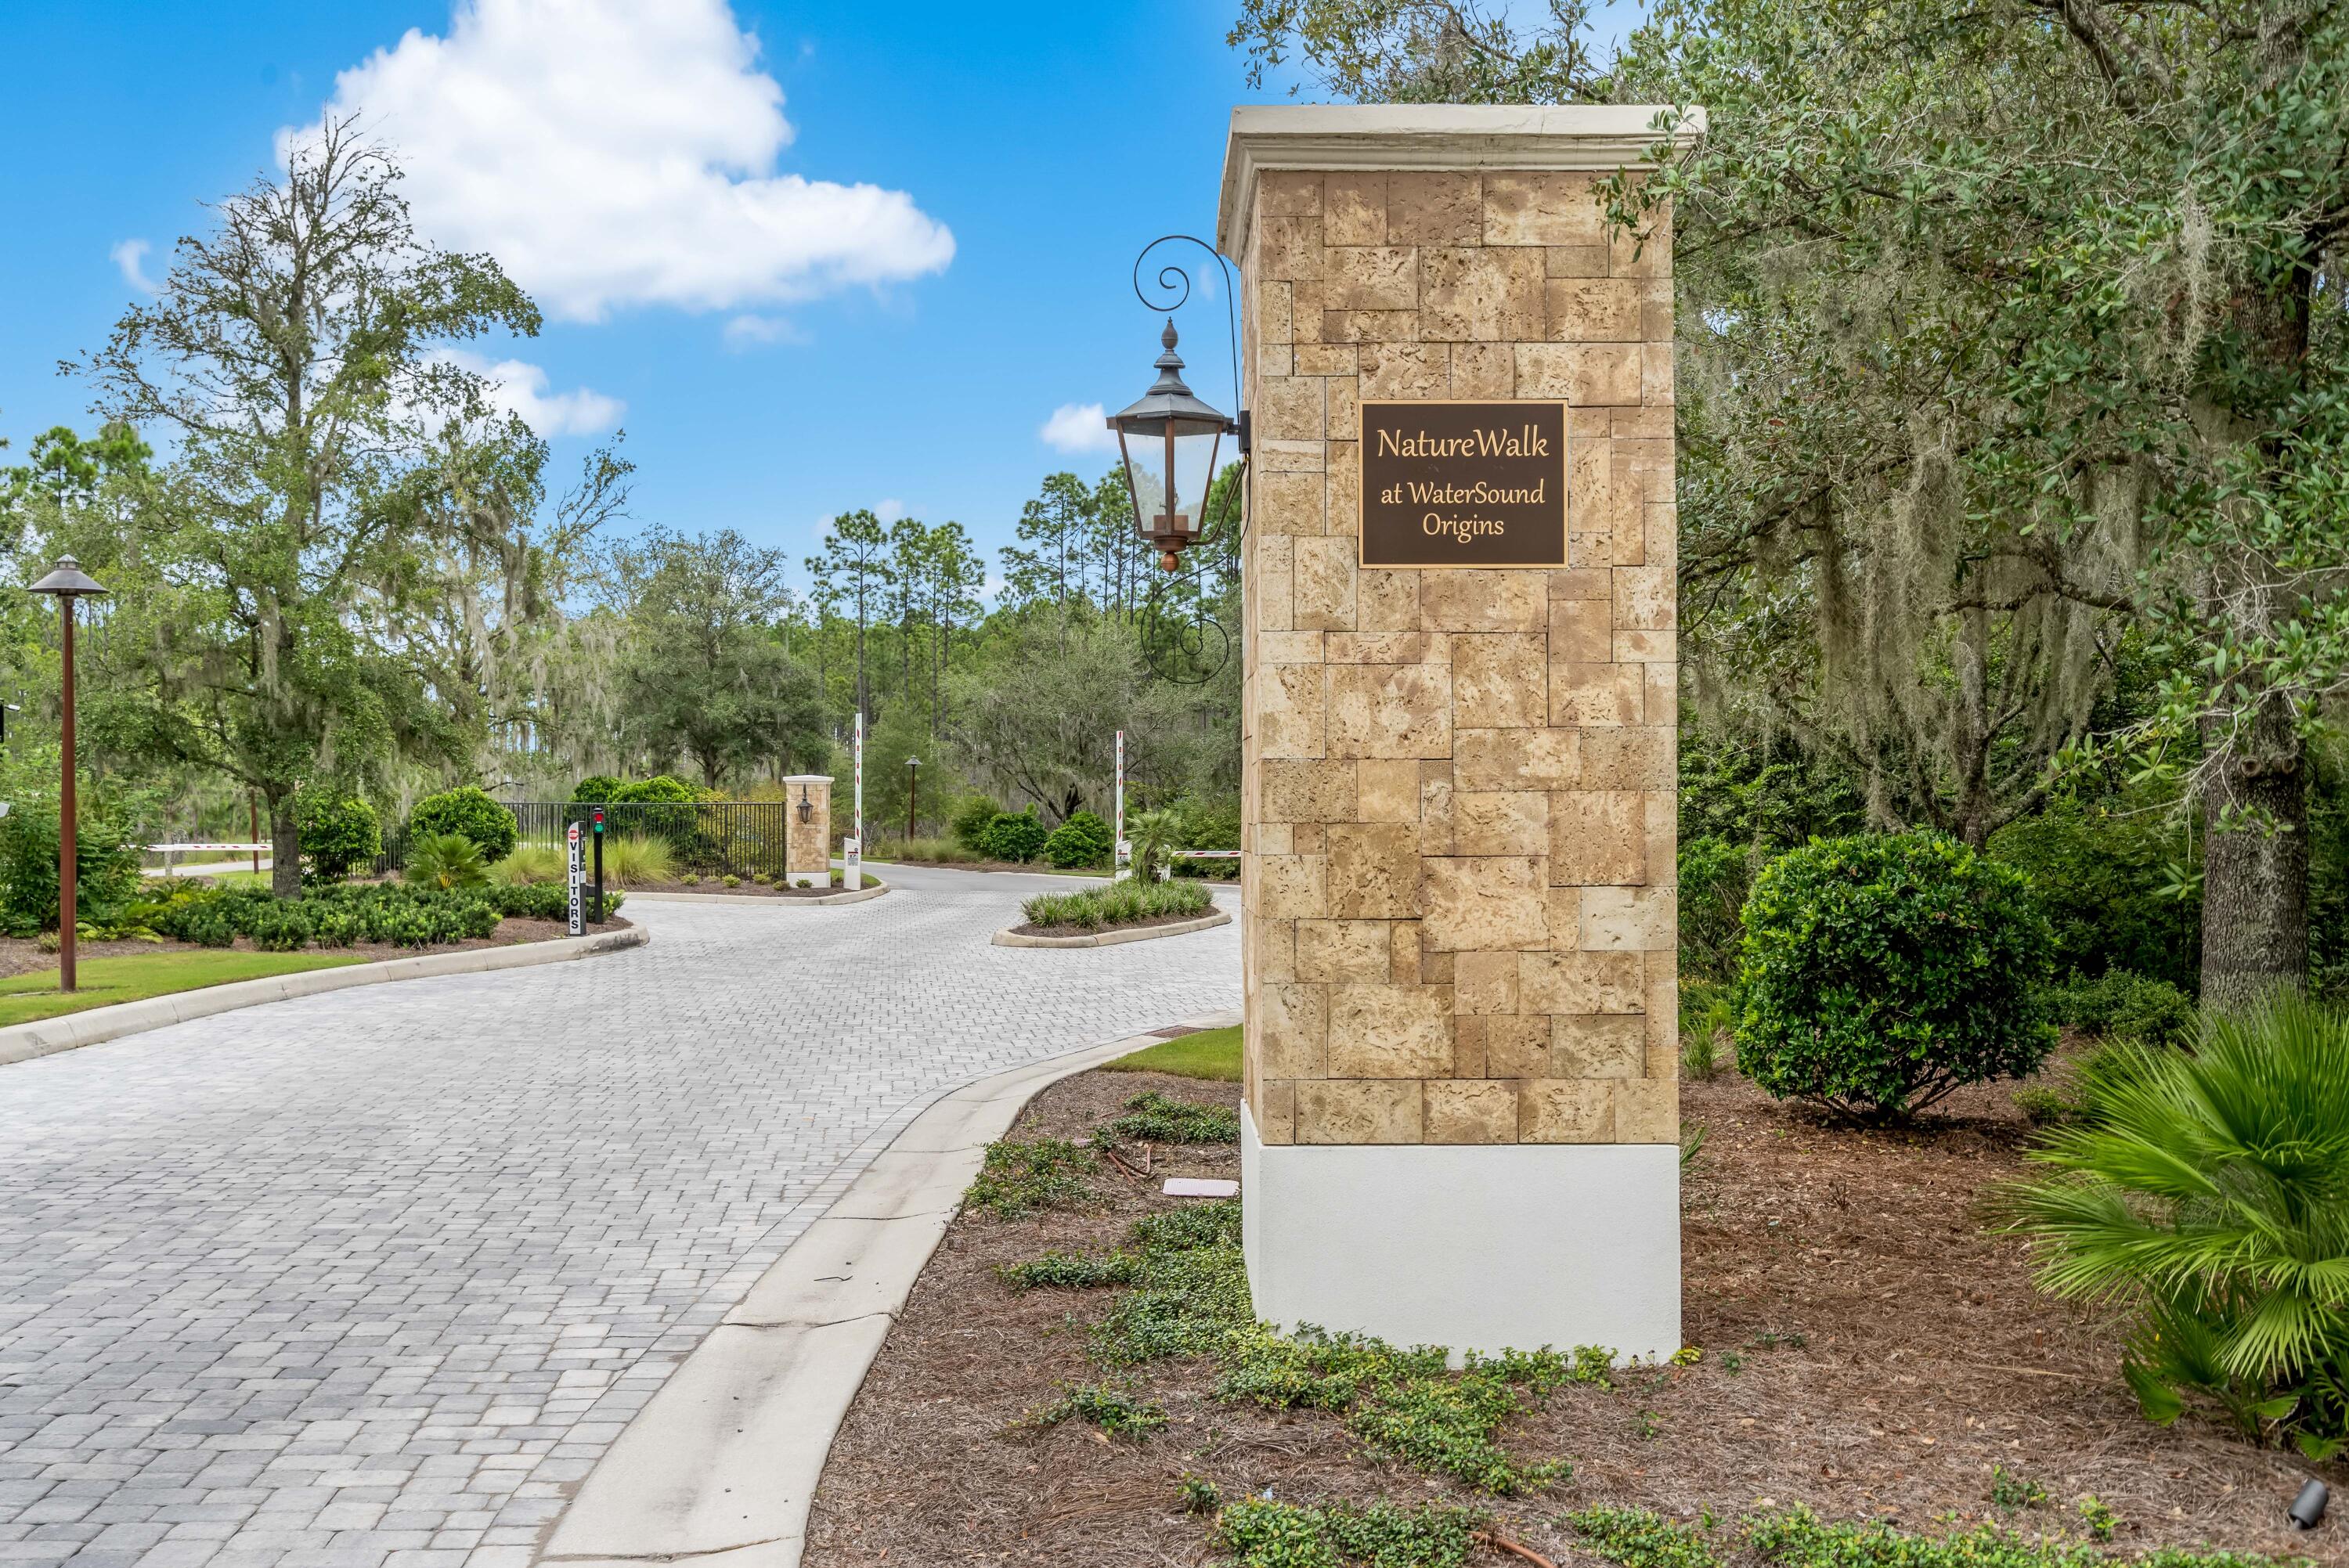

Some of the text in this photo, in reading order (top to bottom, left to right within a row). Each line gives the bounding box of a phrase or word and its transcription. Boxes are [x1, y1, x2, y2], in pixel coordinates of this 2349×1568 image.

[1377, 424, 1550, 457] NatureWalk
[1380, 478, 1546, 504] at WaterSound
[1423, 513, 1504, 543] Origins
[570, 842, 579, 929] VISITORS
